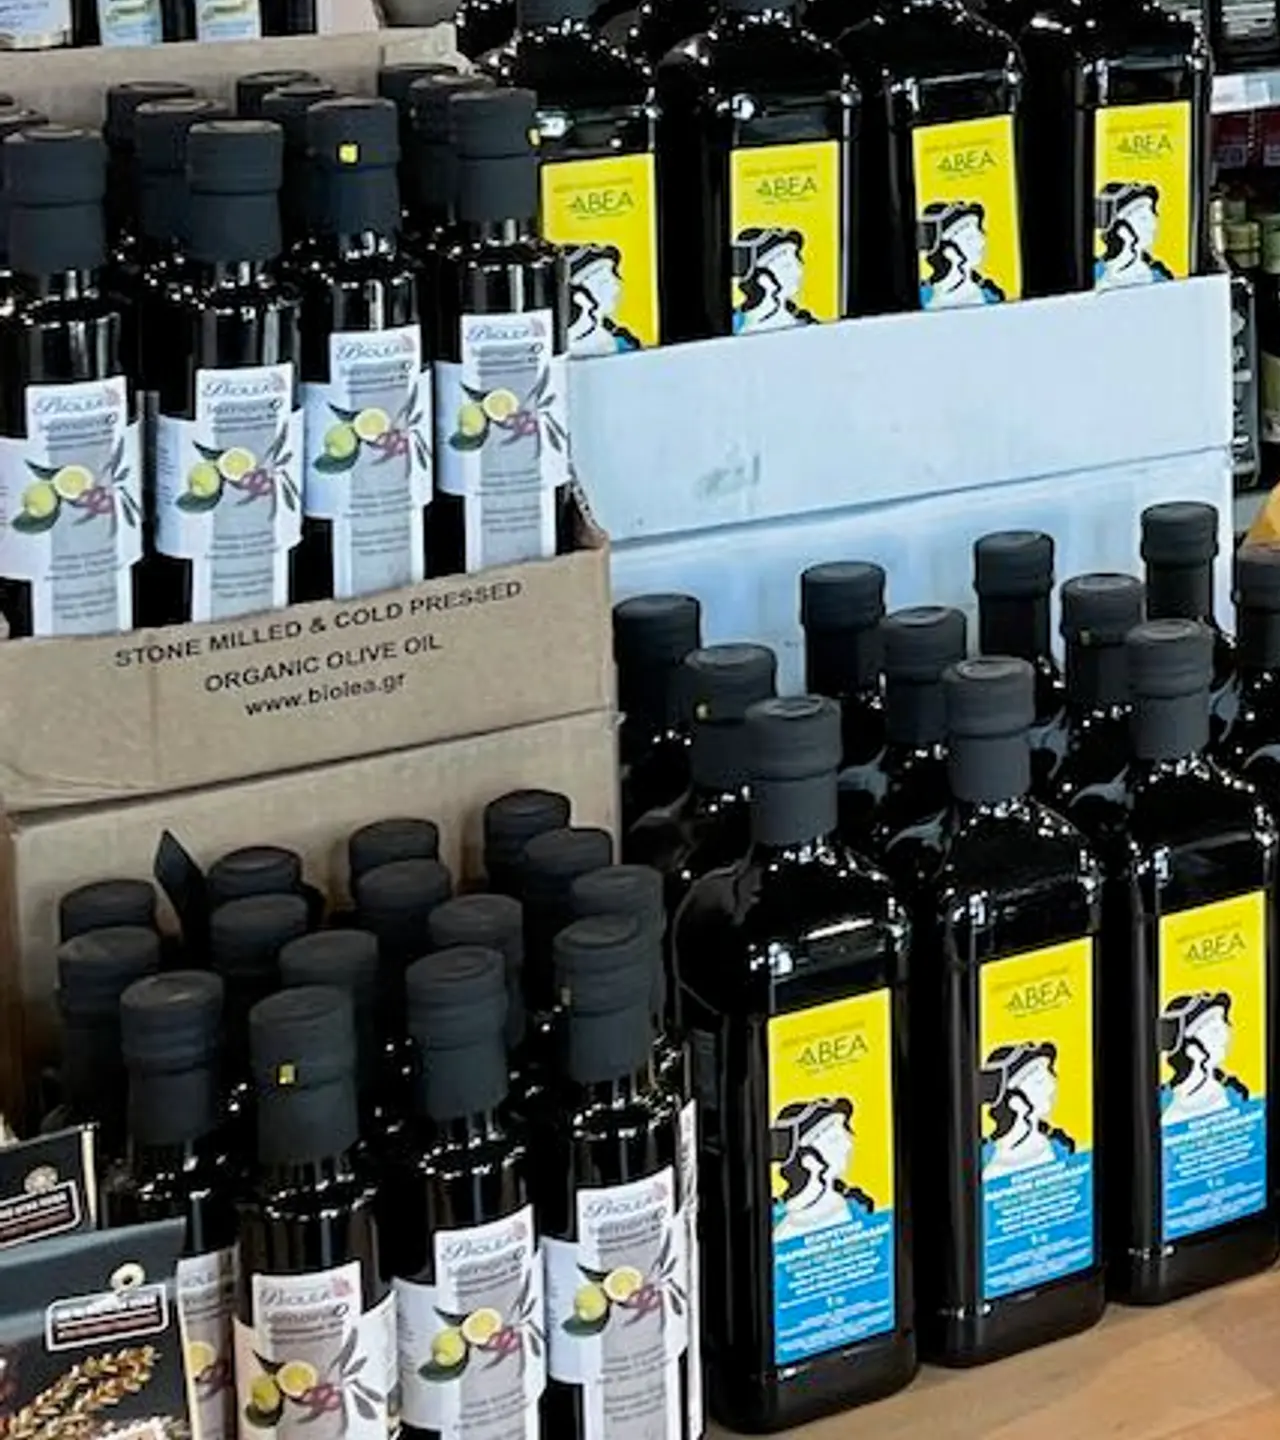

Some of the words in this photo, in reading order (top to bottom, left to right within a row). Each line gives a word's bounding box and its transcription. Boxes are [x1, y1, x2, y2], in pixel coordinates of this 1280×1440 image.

[937, 149, 996, 173] ABEA
[567, 190, 635, 215] ABEA
[755, 176, 818, 198] ABEA
[114, 636, 201, 668] STONE
[208, 618, 303, 654] MILLED
[309, 616, 327, 634] &
[333, 600, 404, 632] COLD
[409, 579, 523, 618] PRESSED
[203, 656, 321, 694] ORGANIC
[325, 642, 398, 671] OLIVE
[403, 632, 444, 657] OIL
[243, 670, 406, 717] www.biolea.gr
[1184, 932, 1247, 963] ABEA
[1003, 979, 1073, 1012] ABEA
[794, 1034, 870, 1066] ABEA
